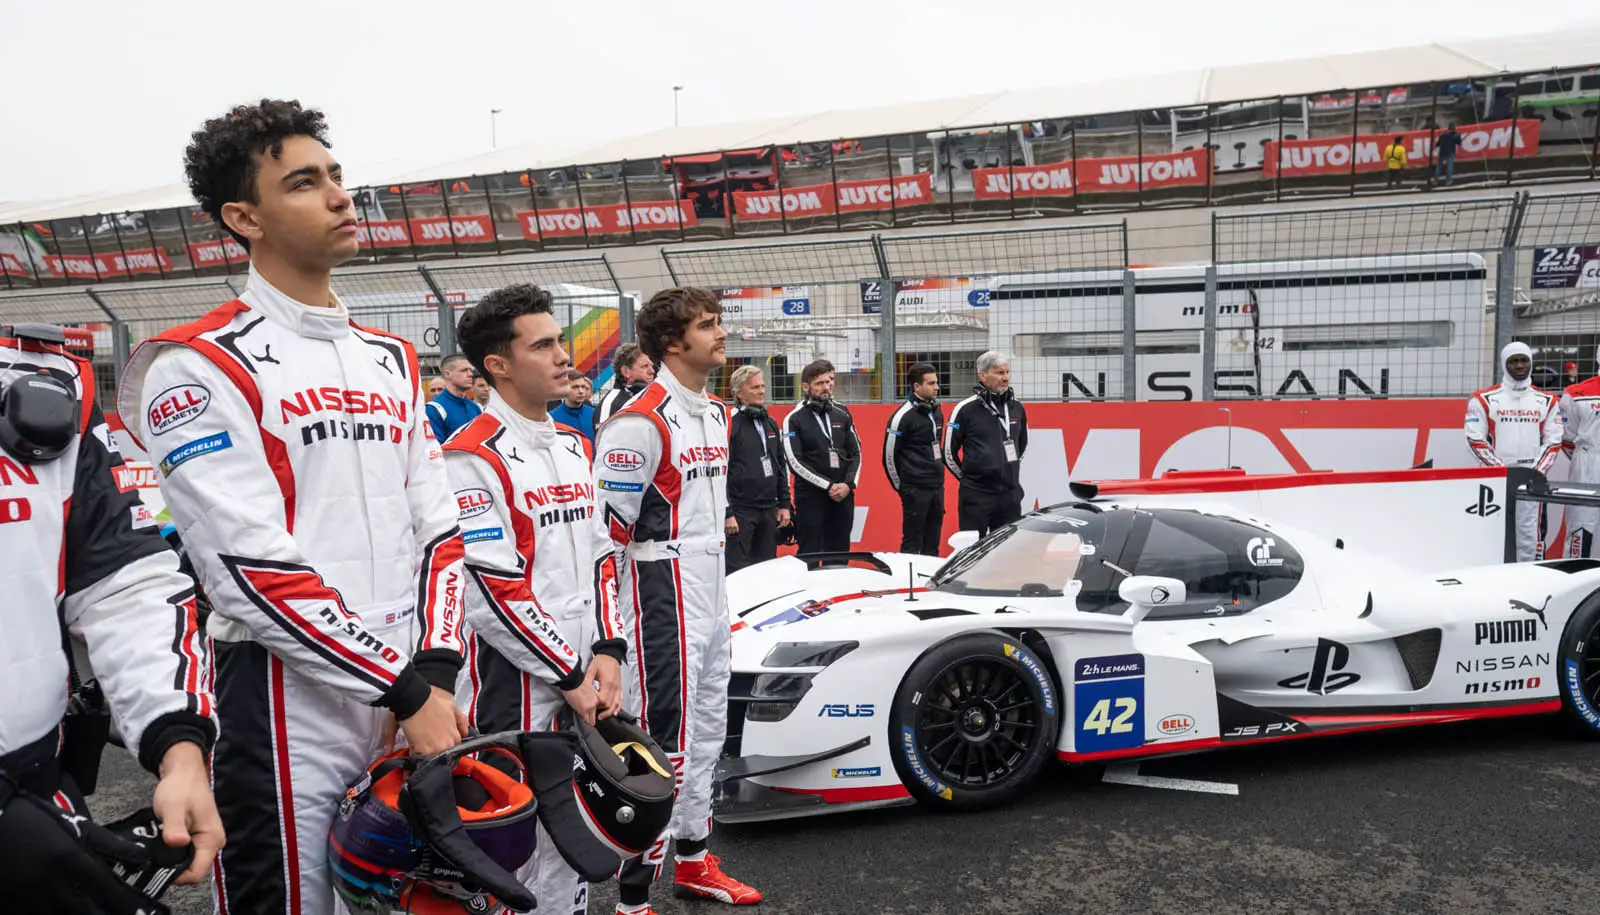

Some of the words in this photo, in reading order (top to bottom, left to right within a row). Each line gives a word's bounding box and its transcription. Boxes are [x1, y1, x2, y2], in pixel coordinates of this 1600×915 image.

[790, 301, 805, 313] 28
[900, 297, 924, 305] AUDI
[1183, 303, 1256, 316] nimo
[1062, 368, 1389, 402] NSSAN
[151, 389, 205, 428] BELL
[280, 386, 407, 424] NISSAN
[1496, 409, 1542, 417] NISSAN
[158, 405, 200, 431] HELMETS
[301, 419, 400, 446] nismo
[171, 438, 224, 463] MICHELIN
[608, 453, 640, 464] BELL
[457, 492, 489, 510] ELL
[460, 505, 486, 516] ELMETS
[540, 505, 594, 527] nimo
[463, 531, 499, 541] MICHELIN
[440, 571, 458, 644] NISSAN
[1475, 618, 1537, 645] PUMA
[1101, 665, 1112, 673] LE
[1112, 664, 1138, 673] MANS
[1456, 652, 1550, 674] NISSAN
[1021, 655, 1054, 709] MICHELIN
[1464, 676, 1541, 694] nismo
[1568, 666, 1598, 724] MICHELIN
[817, 704, 875, 717] ASUS
[1083, 696, 1137, 735] 42
[1162, 718, 1190, 730] BELL
[904, 731, 936, 787] MICHELIN
[845, 768, 878, 777] MICHELIN
